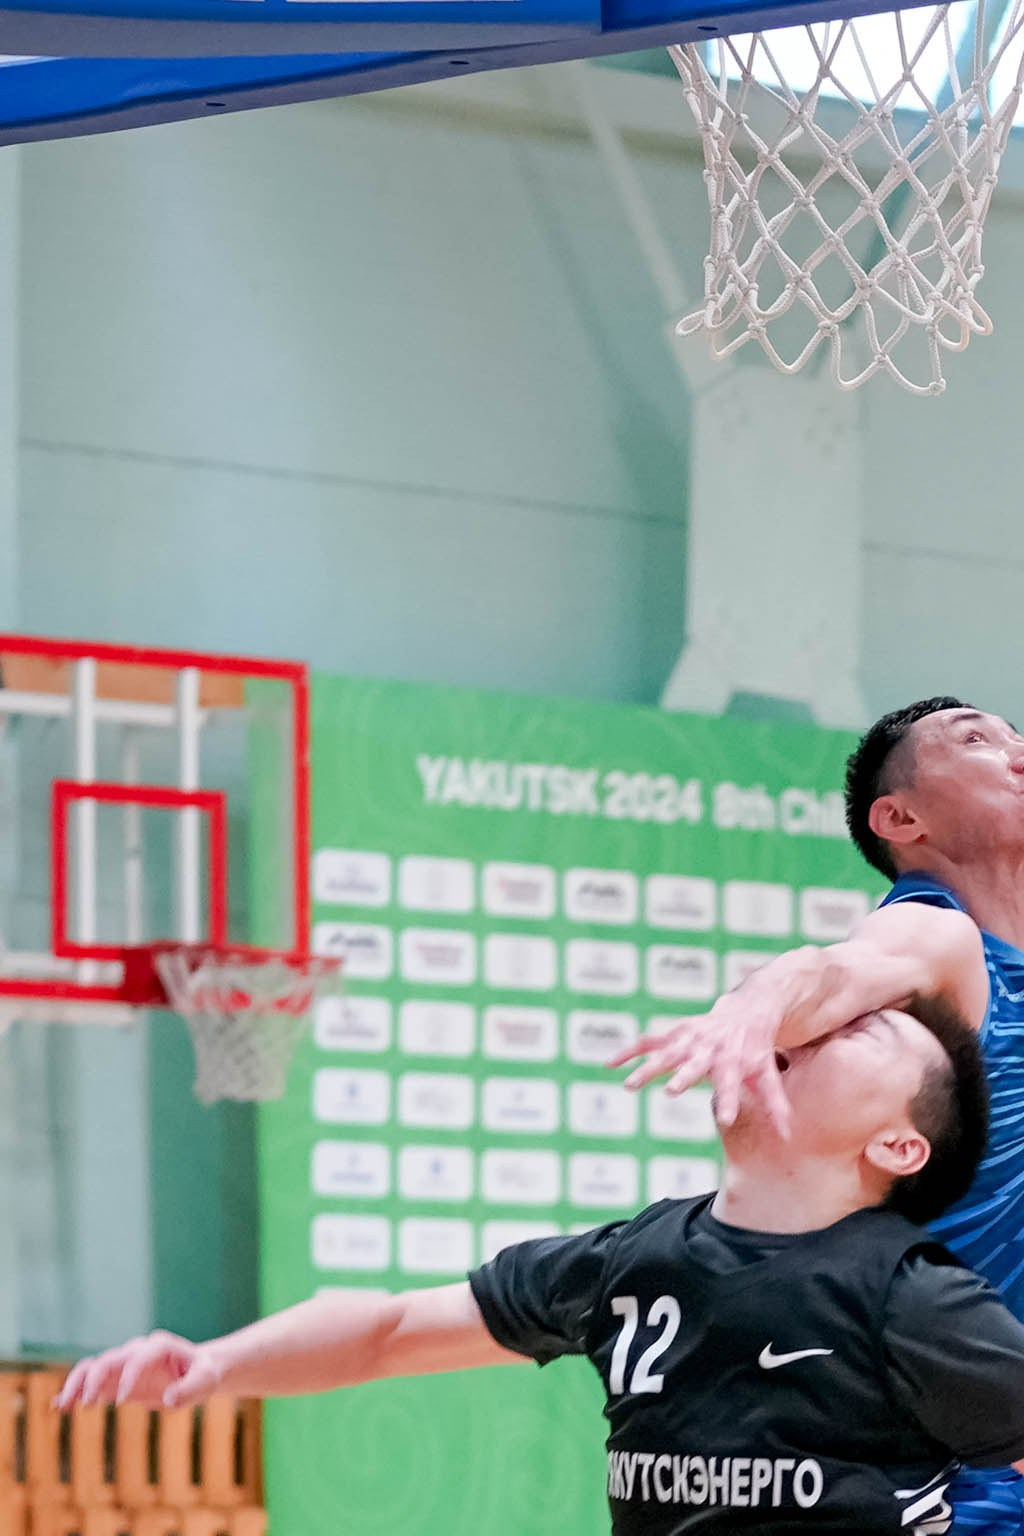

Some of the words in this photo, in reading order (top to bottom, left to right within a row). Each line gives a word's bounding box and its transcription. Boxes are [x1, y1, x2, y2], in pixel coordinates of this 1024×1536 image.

[417, 754, 599, 816] YAKUTSK
[601, 770, 702, 824] 2024
[713, 781, 775, 831] 8th
